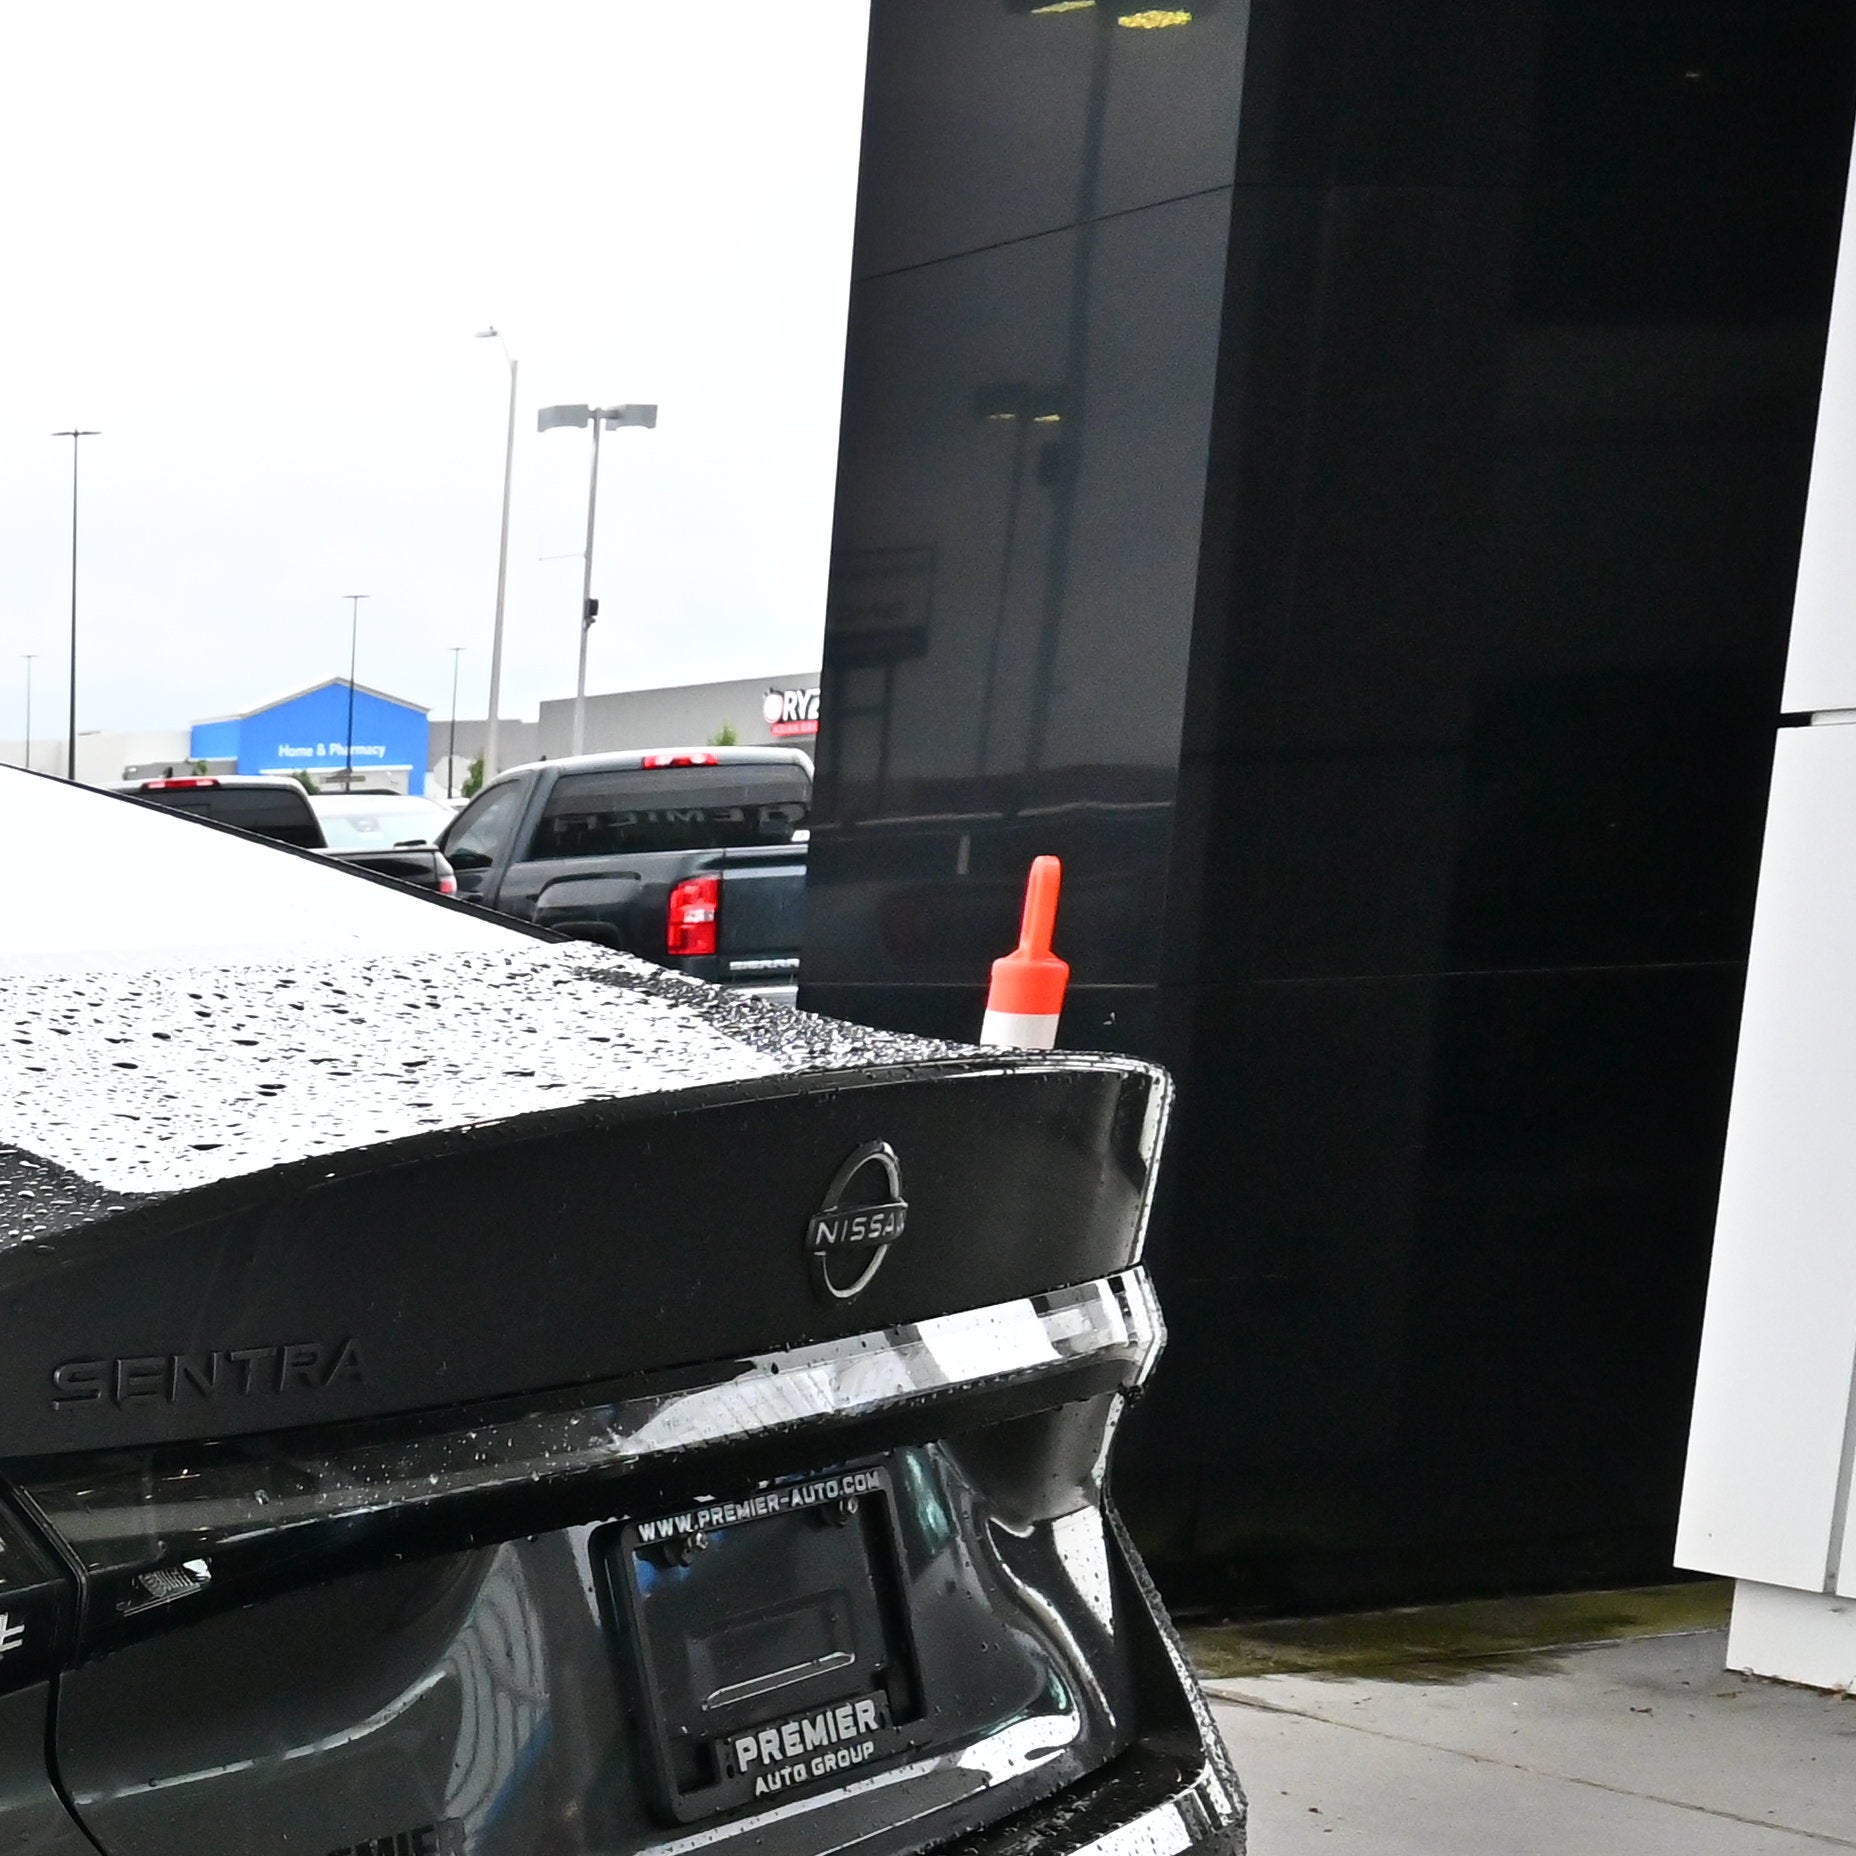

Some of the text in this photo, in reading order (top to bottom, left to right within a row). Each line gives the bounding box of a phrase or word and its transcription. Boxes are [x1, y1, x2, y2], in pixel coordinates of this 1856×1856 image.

[278, 743, 386, 758] Home & Pharmacy
[815, 1211, 905, 1245] NISSAN
[51, 1337, 364, 1412] SENTRA
[638, 1470, 881, 1542] WWW.PREMIER-AUTO.COM
[735, 1699, 879, 1772] PREMIER
[755, 1741, 875, 1796] AUTO GROUP
